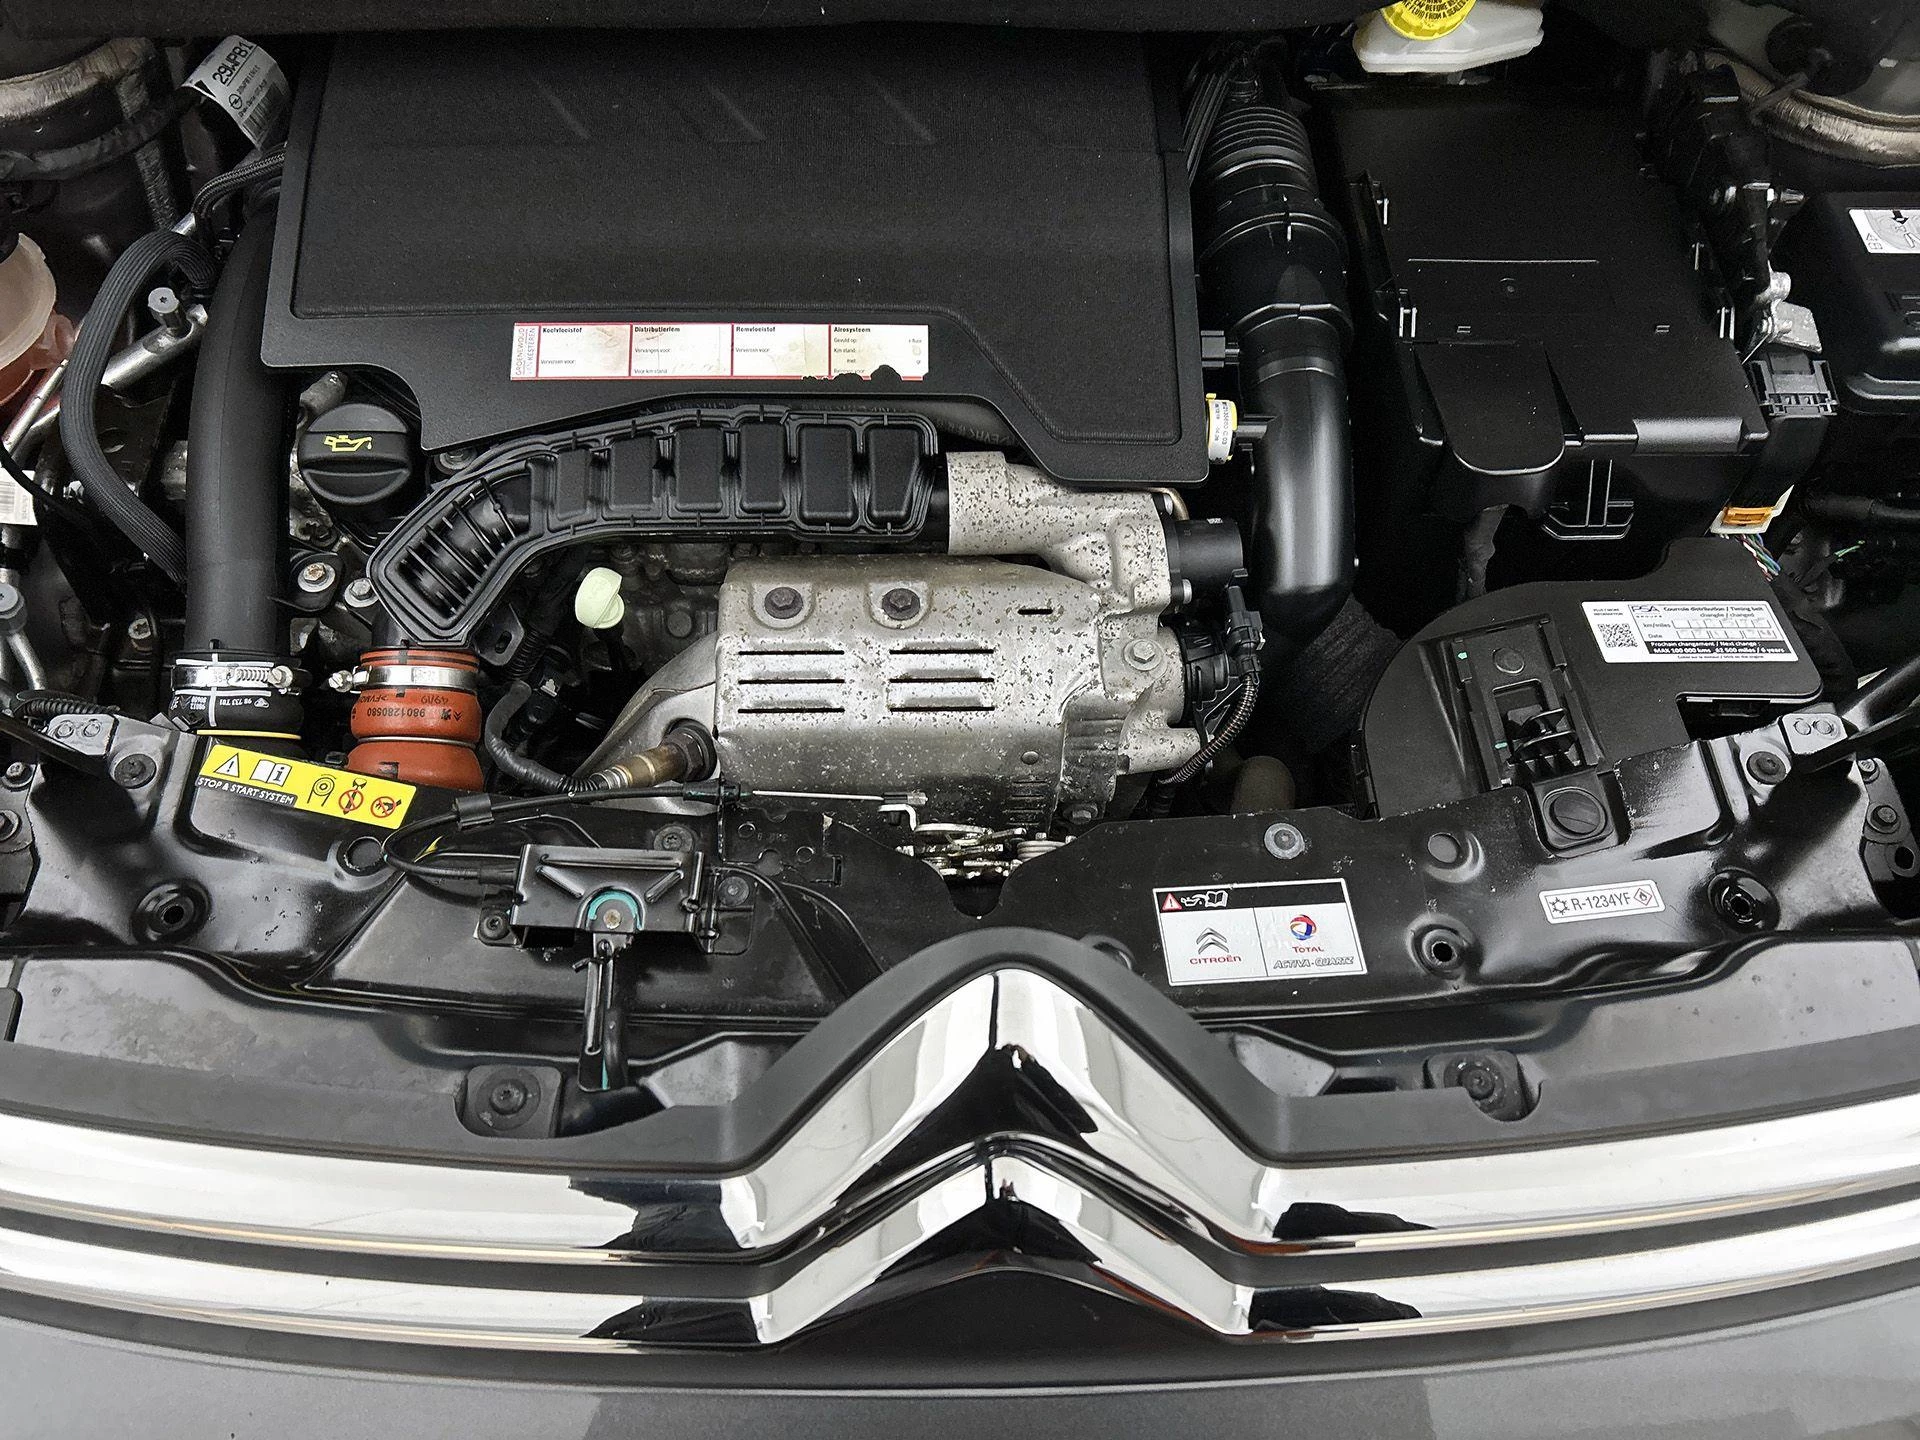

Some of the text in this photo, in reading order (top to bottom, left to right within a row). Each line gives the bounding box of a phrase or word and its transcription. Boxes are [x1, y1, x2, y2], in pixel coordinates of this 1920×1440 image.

[526, 328, 535, 361] KESTEREN
[198, 777, 295, 804] STOP & START SYSTEM
[1570, 891, 1631, 911] R-1234YF
